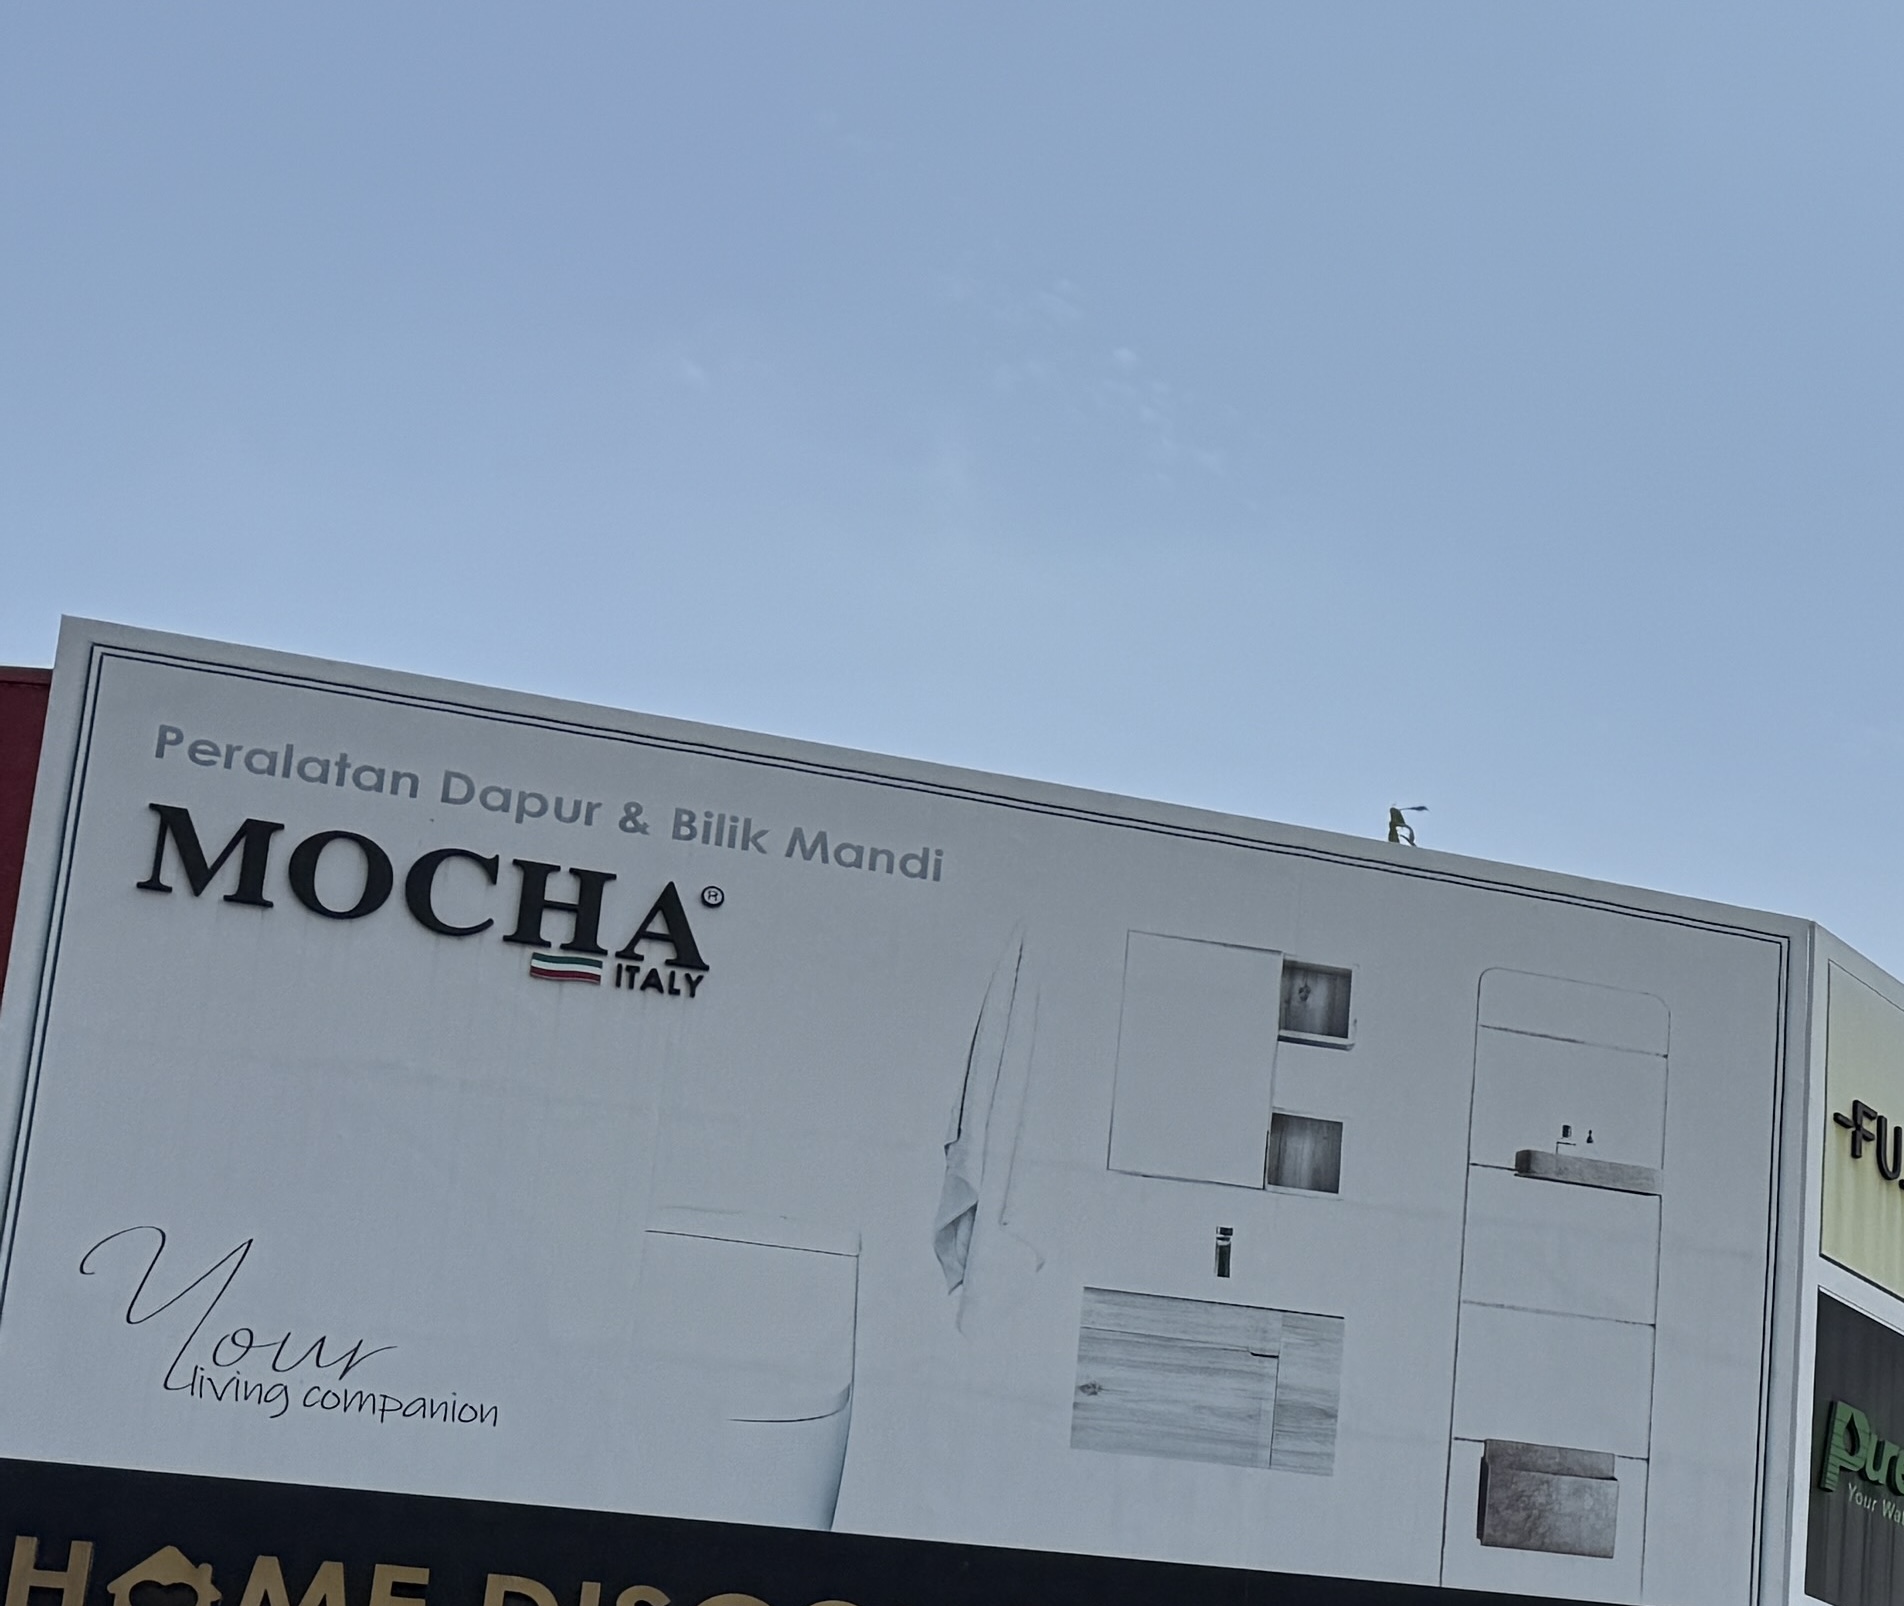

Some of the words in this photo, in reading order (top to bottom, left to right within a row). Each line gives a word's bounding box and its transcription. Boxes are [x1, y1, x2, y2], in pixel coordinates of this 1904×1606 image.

[154, 723, 421, 800] Peralatan
[441, 769, 603, 828] Dapur
[618, 801, 650, 836] &
[671, 807, 770, 855] Bilik
[784, 826, 945, 883] Mandi
[137, 803, 710, 972] MOCHA
[614, 962, 706, 998] ITALY
[79, 1225, 398, 1391] Your
[188, 1363, 290, 1420] living
[302, 1380, 500, 1428] companion
[1848, 1482, 1877, 1512] Your
